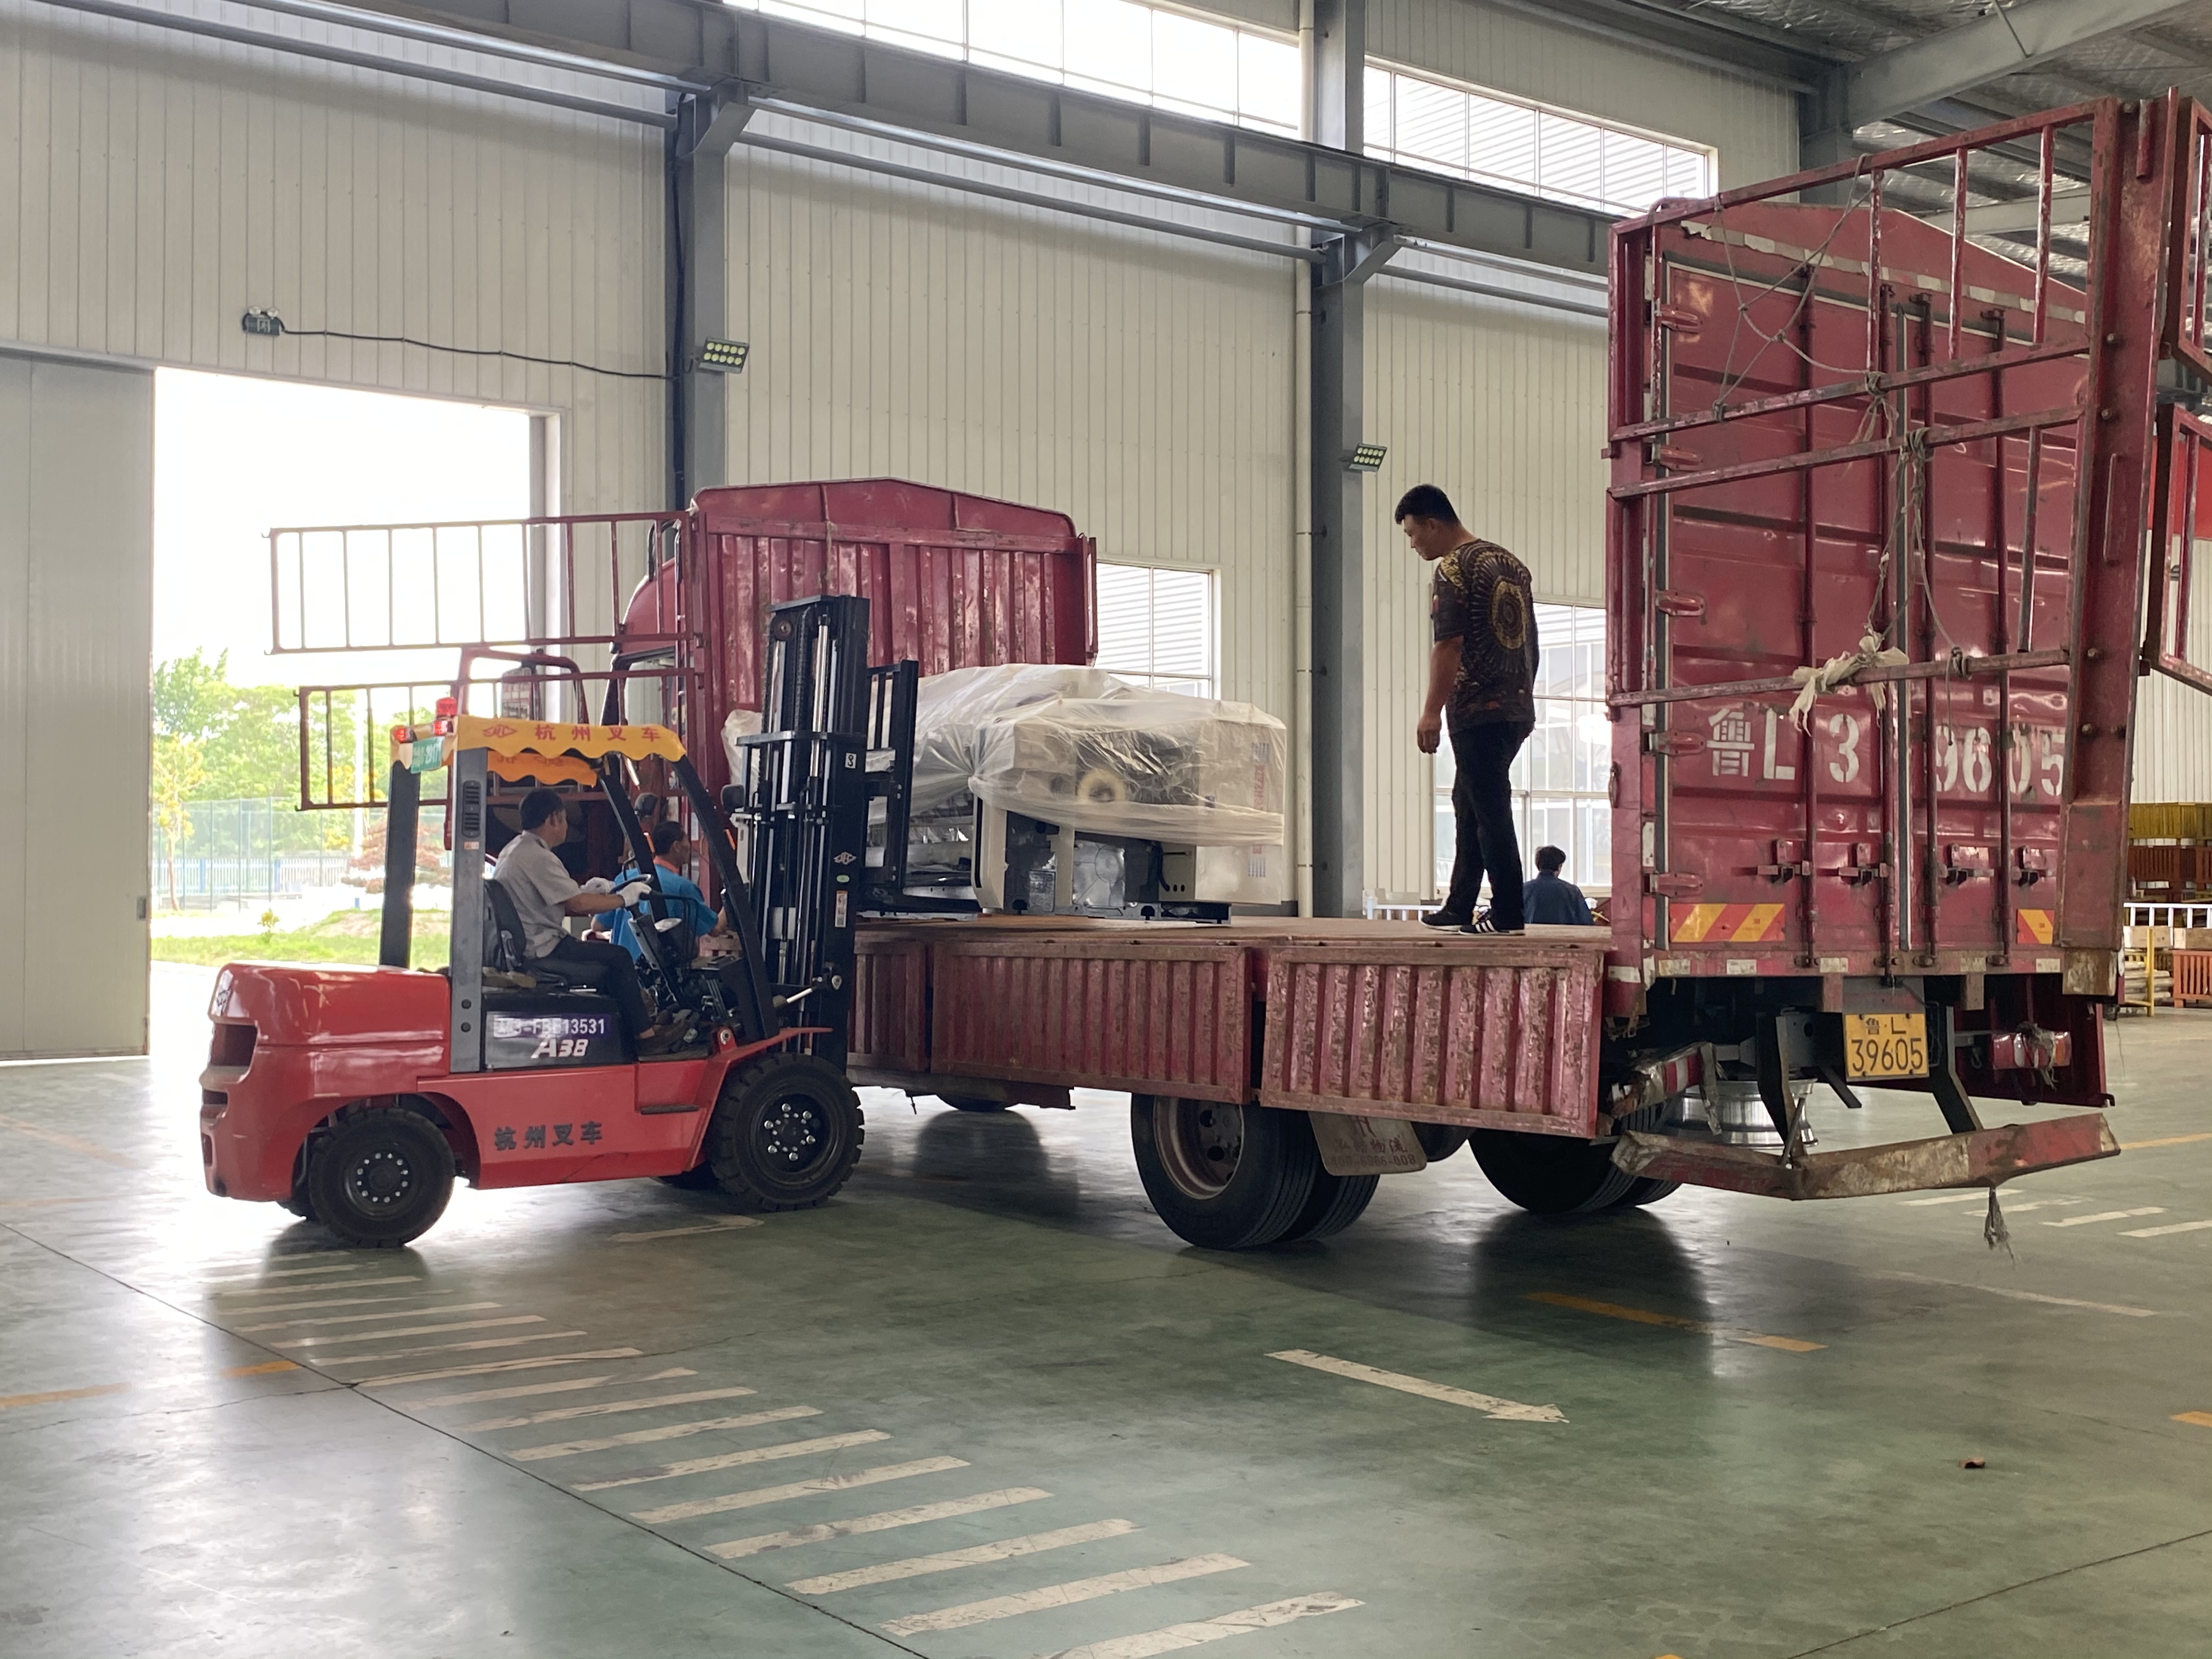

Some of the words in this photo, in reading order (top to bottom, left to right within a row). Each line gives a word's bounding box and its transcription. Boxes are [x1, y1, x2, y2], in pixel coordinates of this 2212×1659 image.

[534, 724, 662, 742] 杭州叉车
[1851, 1037, 1923, 1072] 39605
[495, 1121, 602, 1151] 杭州叉车
[1334, 1136, 1409, 1153] 物流
